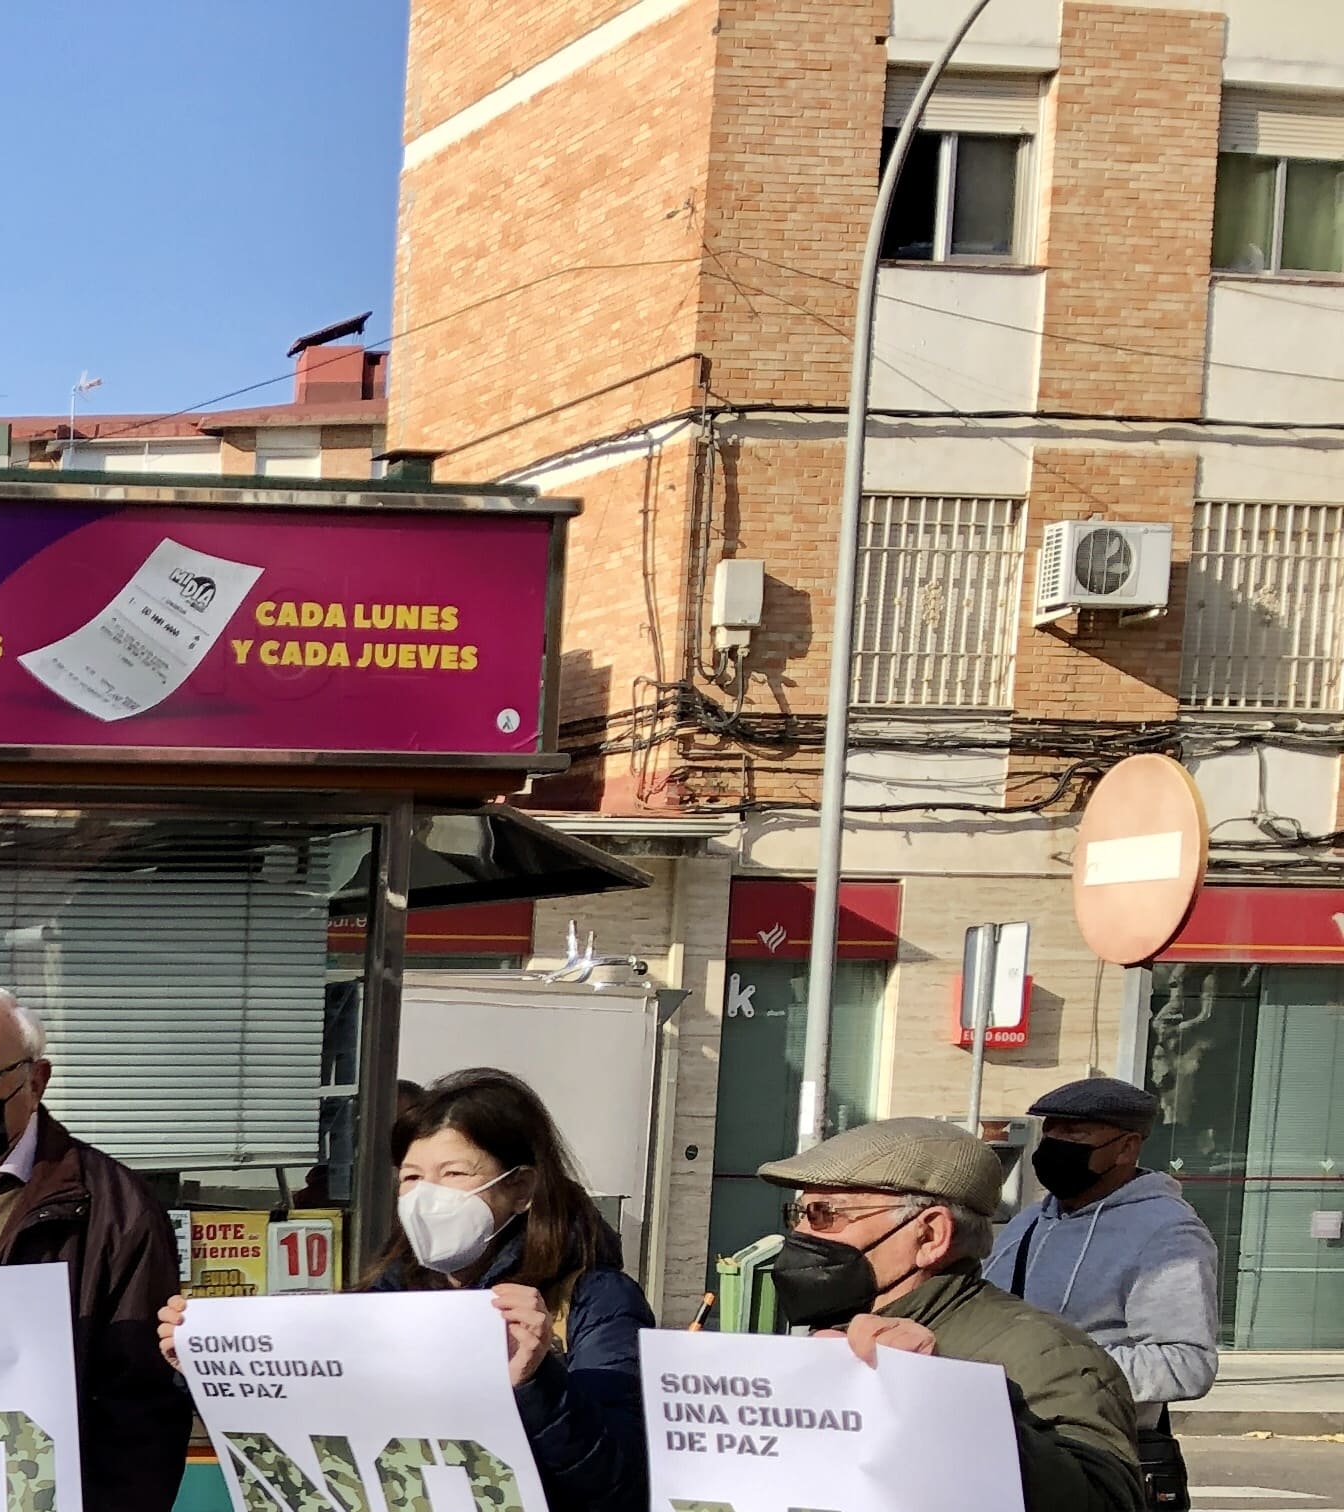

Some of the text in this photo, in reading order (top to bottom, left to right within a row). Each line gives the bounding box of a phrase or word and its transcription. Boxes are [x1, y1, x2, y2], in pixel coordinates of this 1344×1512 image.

[255, 601, 459, 631] CADA LUNES
[232, 640, 478, 671] Y CADA JUEVES
[995, 1032, 1025, 1042] 6000
[192, 1224, 245, 1240] BOTE
[192, 1243, 261, 1258] viernes
[279, 1231, 328, 1277] 10
[188, 1335, 274, 1352] SOMOS
[195, 1360, 343, 1377] UNA CIUDAD
[202, 1382, 287, 1398] DE PAZ
[661, 1373, 773, 1398] SOMOS
[663, 1402, 862, 1432] UNA CIUDAD
[667, 1431, 779, 1457] DE PAZ
